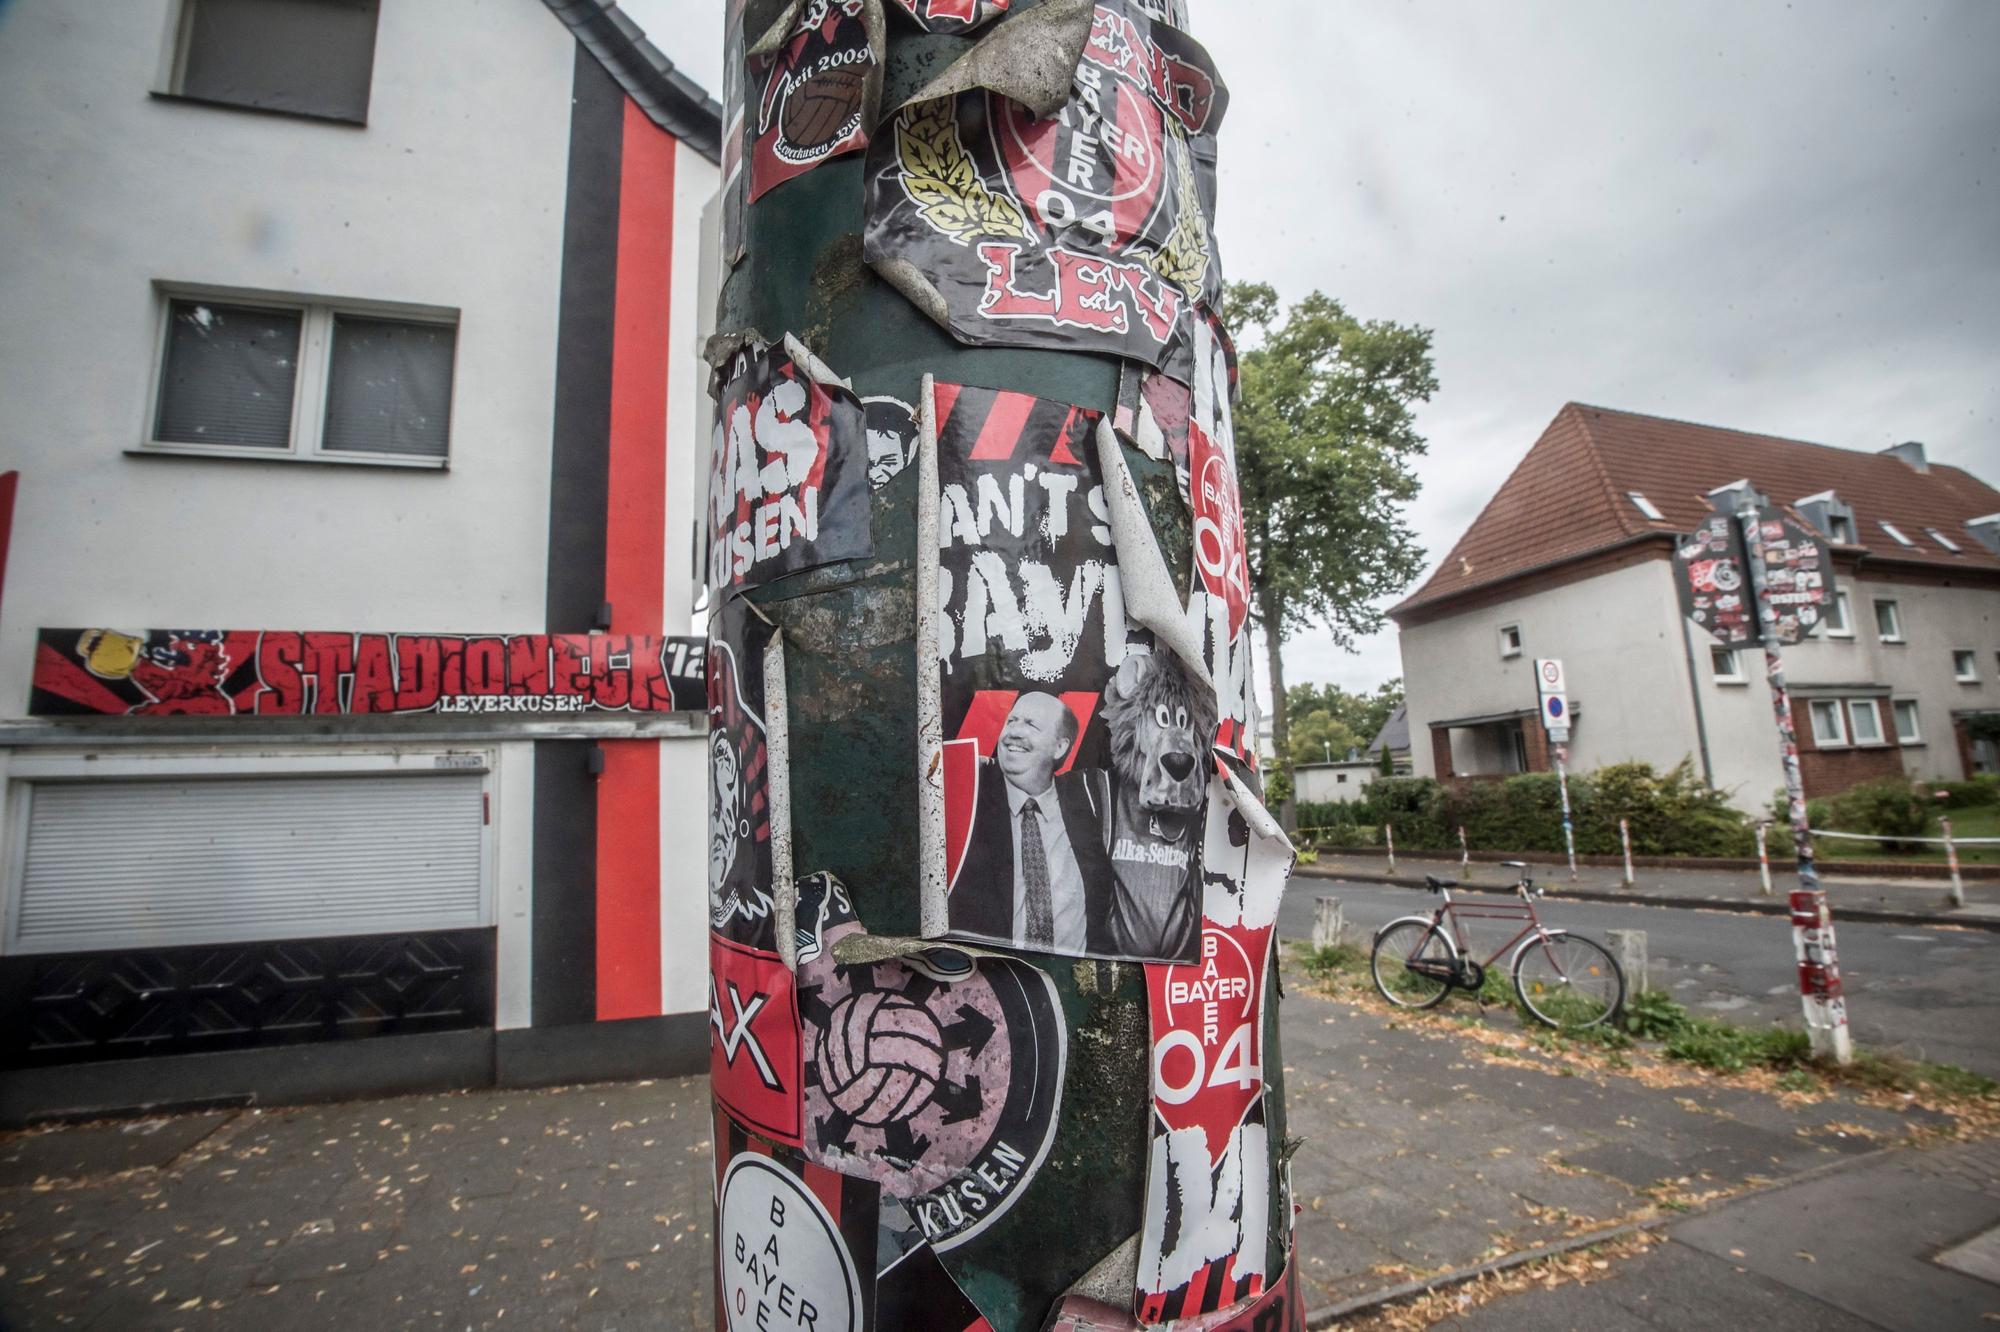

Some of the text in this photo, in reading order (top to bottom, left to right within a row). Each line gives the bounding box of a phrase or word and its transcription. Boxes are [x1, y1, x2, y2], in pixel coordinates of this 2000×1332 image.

[1036, 189, 1118, 249] 04
[977, 242, 1184, 344] LEV
[440, 694, 585, 713] LEVERKUSEN
[1111, 839, 1190, 870] Alka-Seltzer
[1171, 977, 1247, 1004] BAYER
[1203, 936, 1218, 1046] BAYER
[1154, 1022, 1262, 1105] 04
[916, 1140, 1026, 1238] KUSEN
